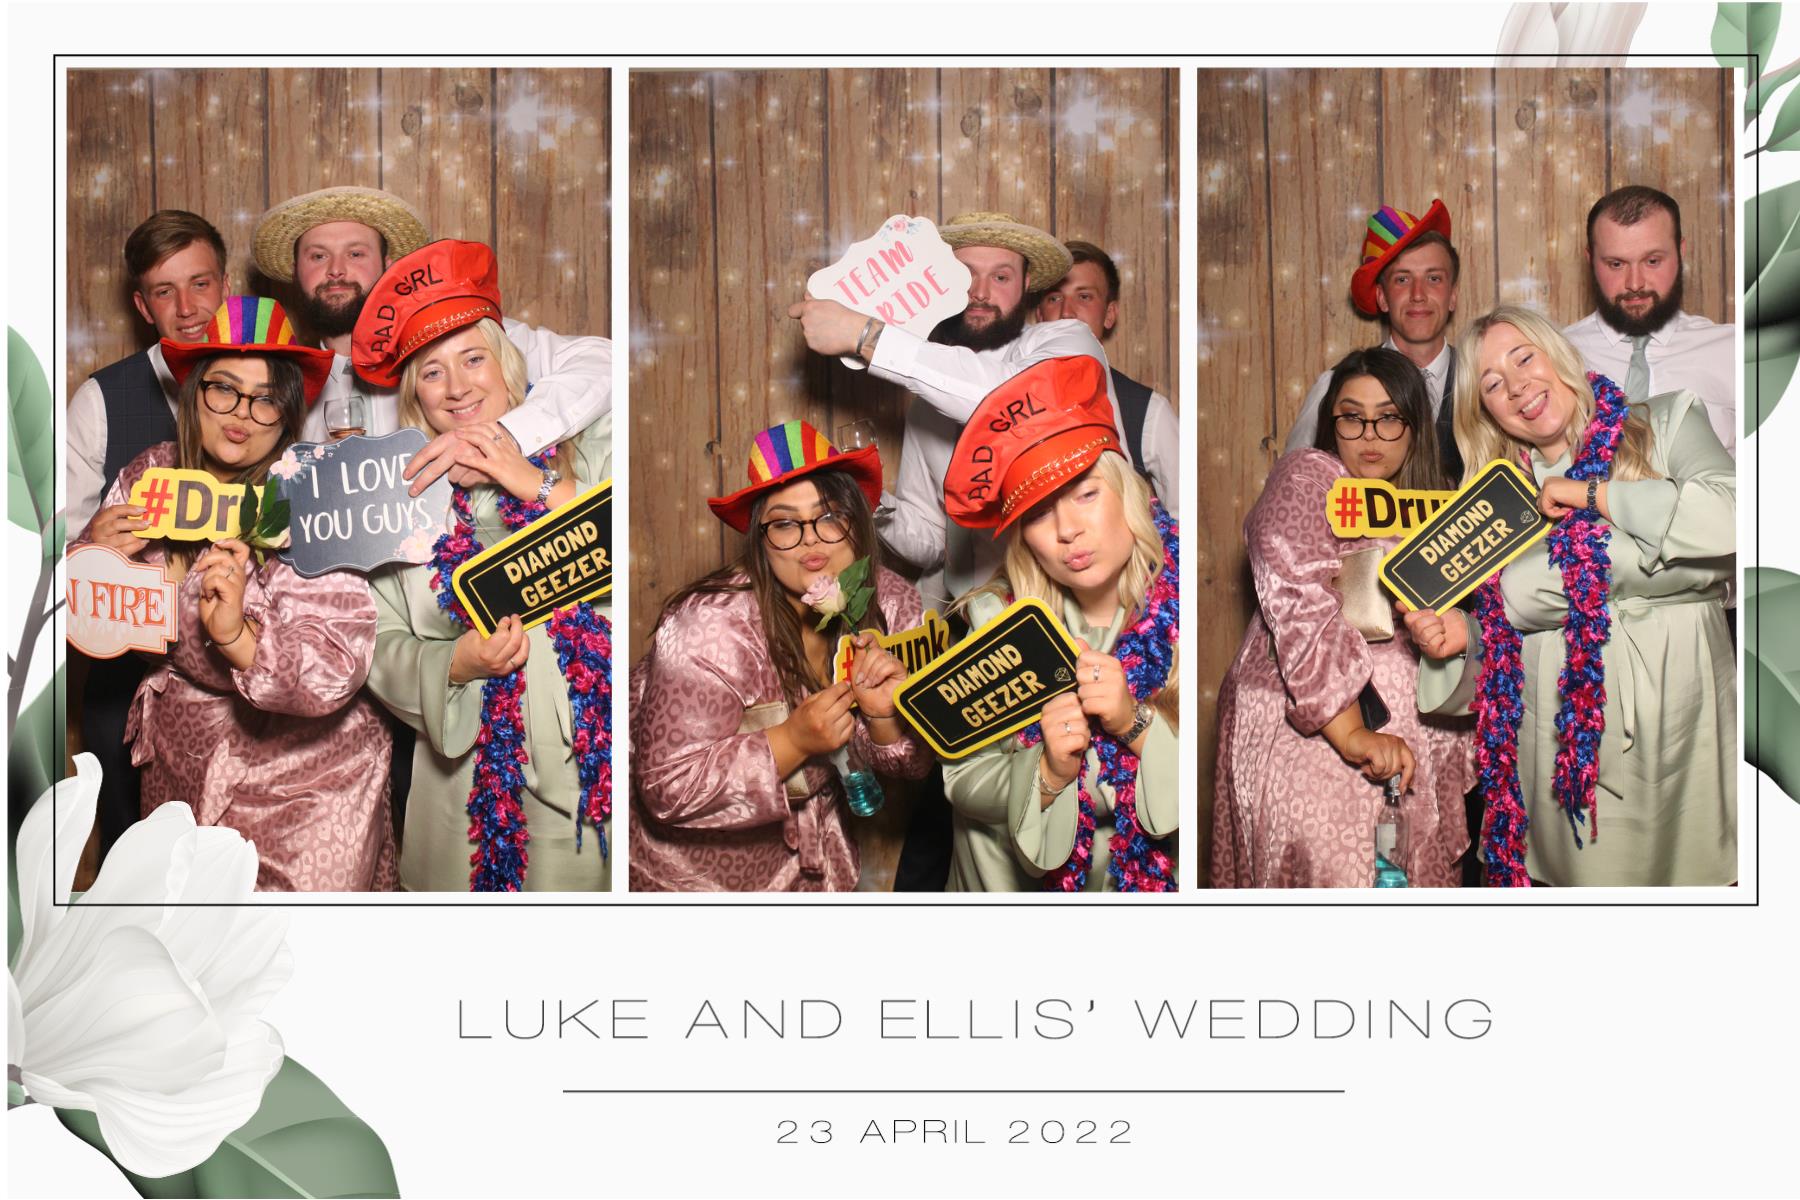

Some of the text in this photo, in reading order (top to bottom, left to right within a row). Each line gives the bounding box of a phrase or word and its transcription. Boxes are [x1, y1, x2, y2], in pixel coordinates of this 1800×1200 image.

[833, 241, 914, 305] TEAM
[875, 265, 949, 326] RIDE
[140, 478, 264, 532] #Dr
[311, 453, 414, 499] I LOVE
[299, 498, 432, 543] YOU GUYS
[1335, 487, 1447, 529] #Dru
[1419, 499, 1494, 566] DIAMOND
[503, 520, 599, 585] DIAMOND
[520, 547, 612, 608] GEEZER
[1440, 518, 1514, 583] GEEZER
[88, 578, 166, 628] FIRE
[936, 643, 1023, 705] DIAMOND
[961, 670, 1057, 728] GEEZER
